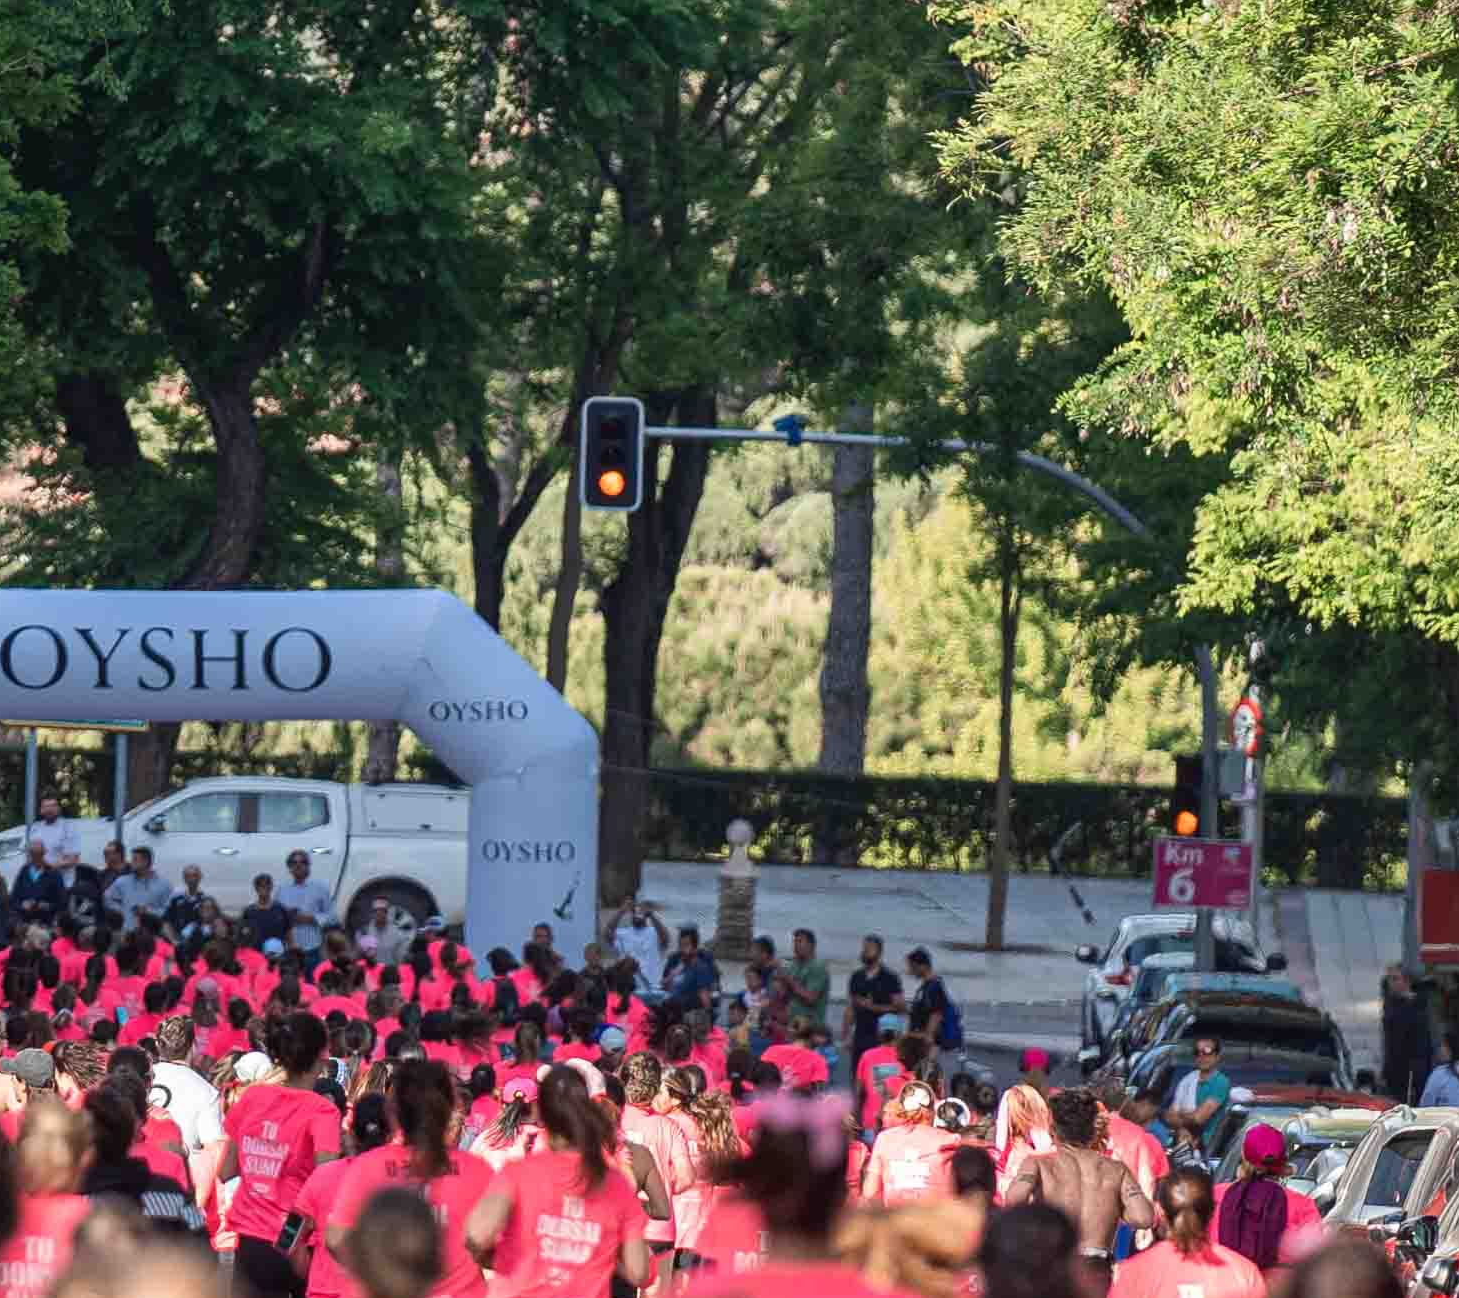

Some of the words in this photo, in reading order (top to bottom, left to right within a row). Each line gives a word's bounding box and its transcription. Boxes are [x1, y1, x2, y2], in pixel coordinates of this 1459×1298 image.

[0, 624, 332, 692] OYSHO
[429, 701, 529, 722] OYSHO
[482, 839, 576, 863] OYSHO
[1164, 843, 1204, 864] Km
[1168, 868, 1196, 902] 6
